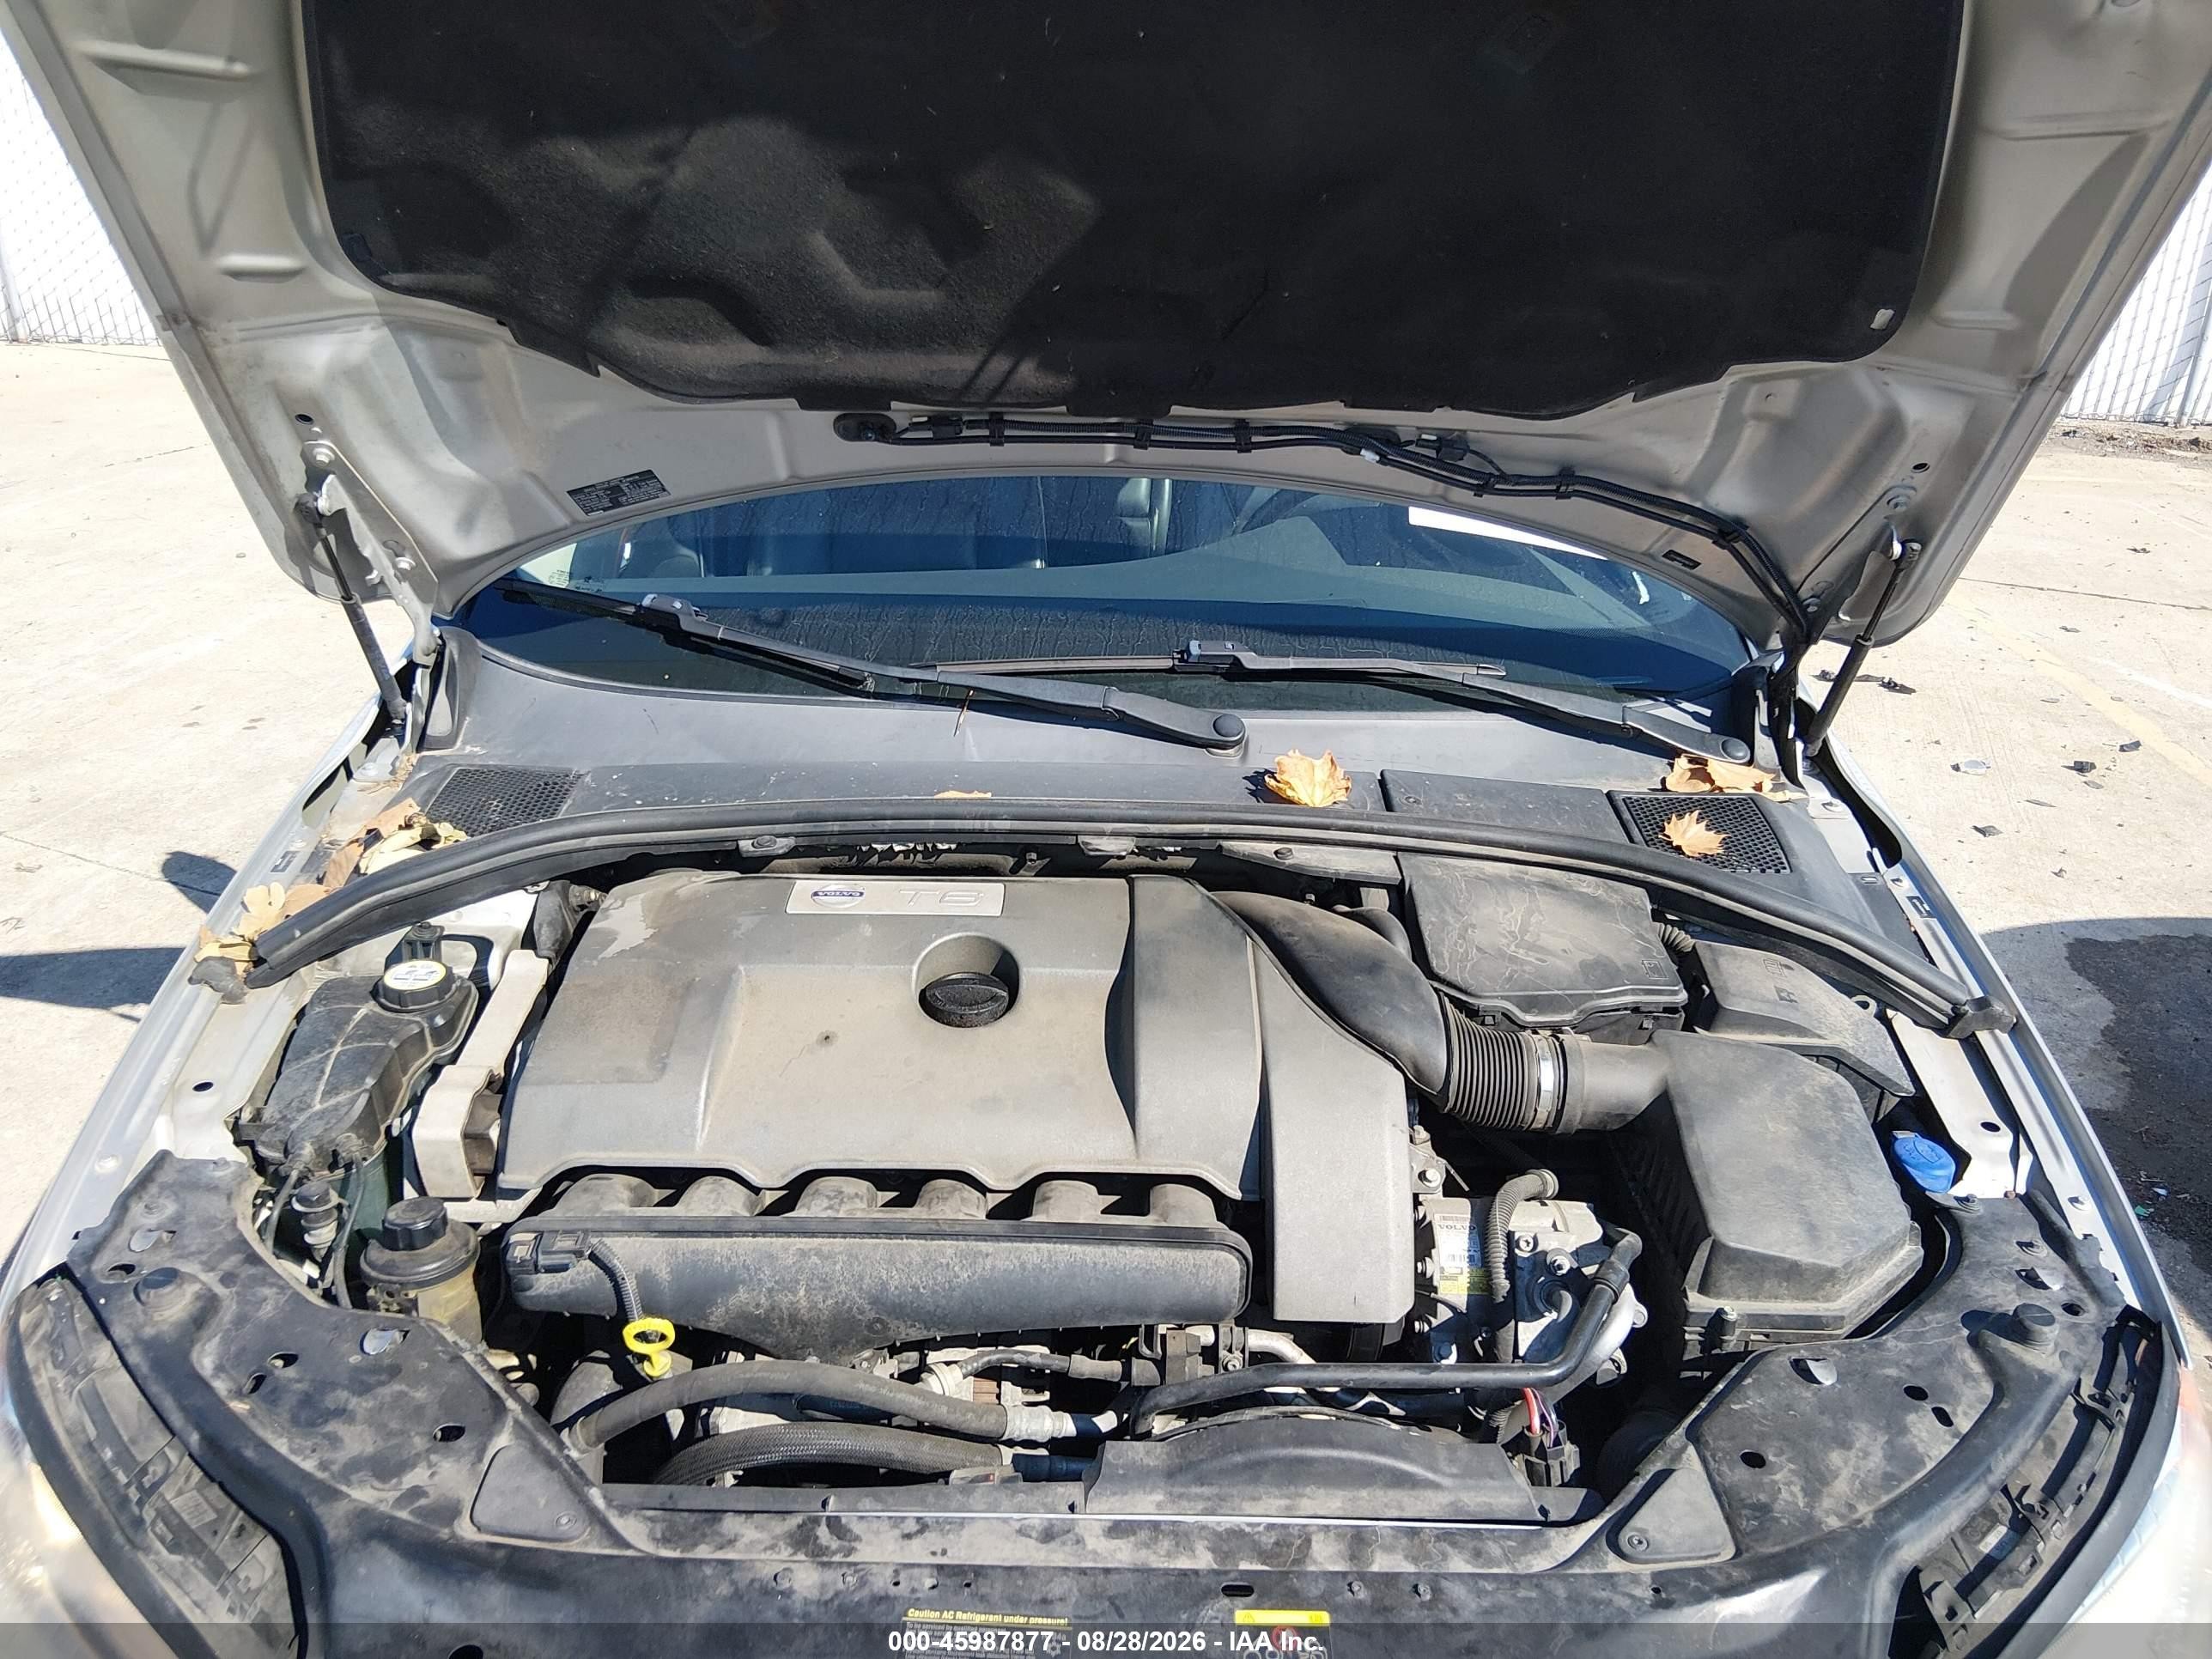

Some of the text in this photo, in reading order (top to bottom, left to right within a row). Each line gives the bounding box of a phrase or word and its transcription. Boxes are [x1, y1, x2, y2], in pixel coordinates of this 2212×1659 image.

[908, 1607, 1068, 1626] Caution AC Refrigerant under pressure!
